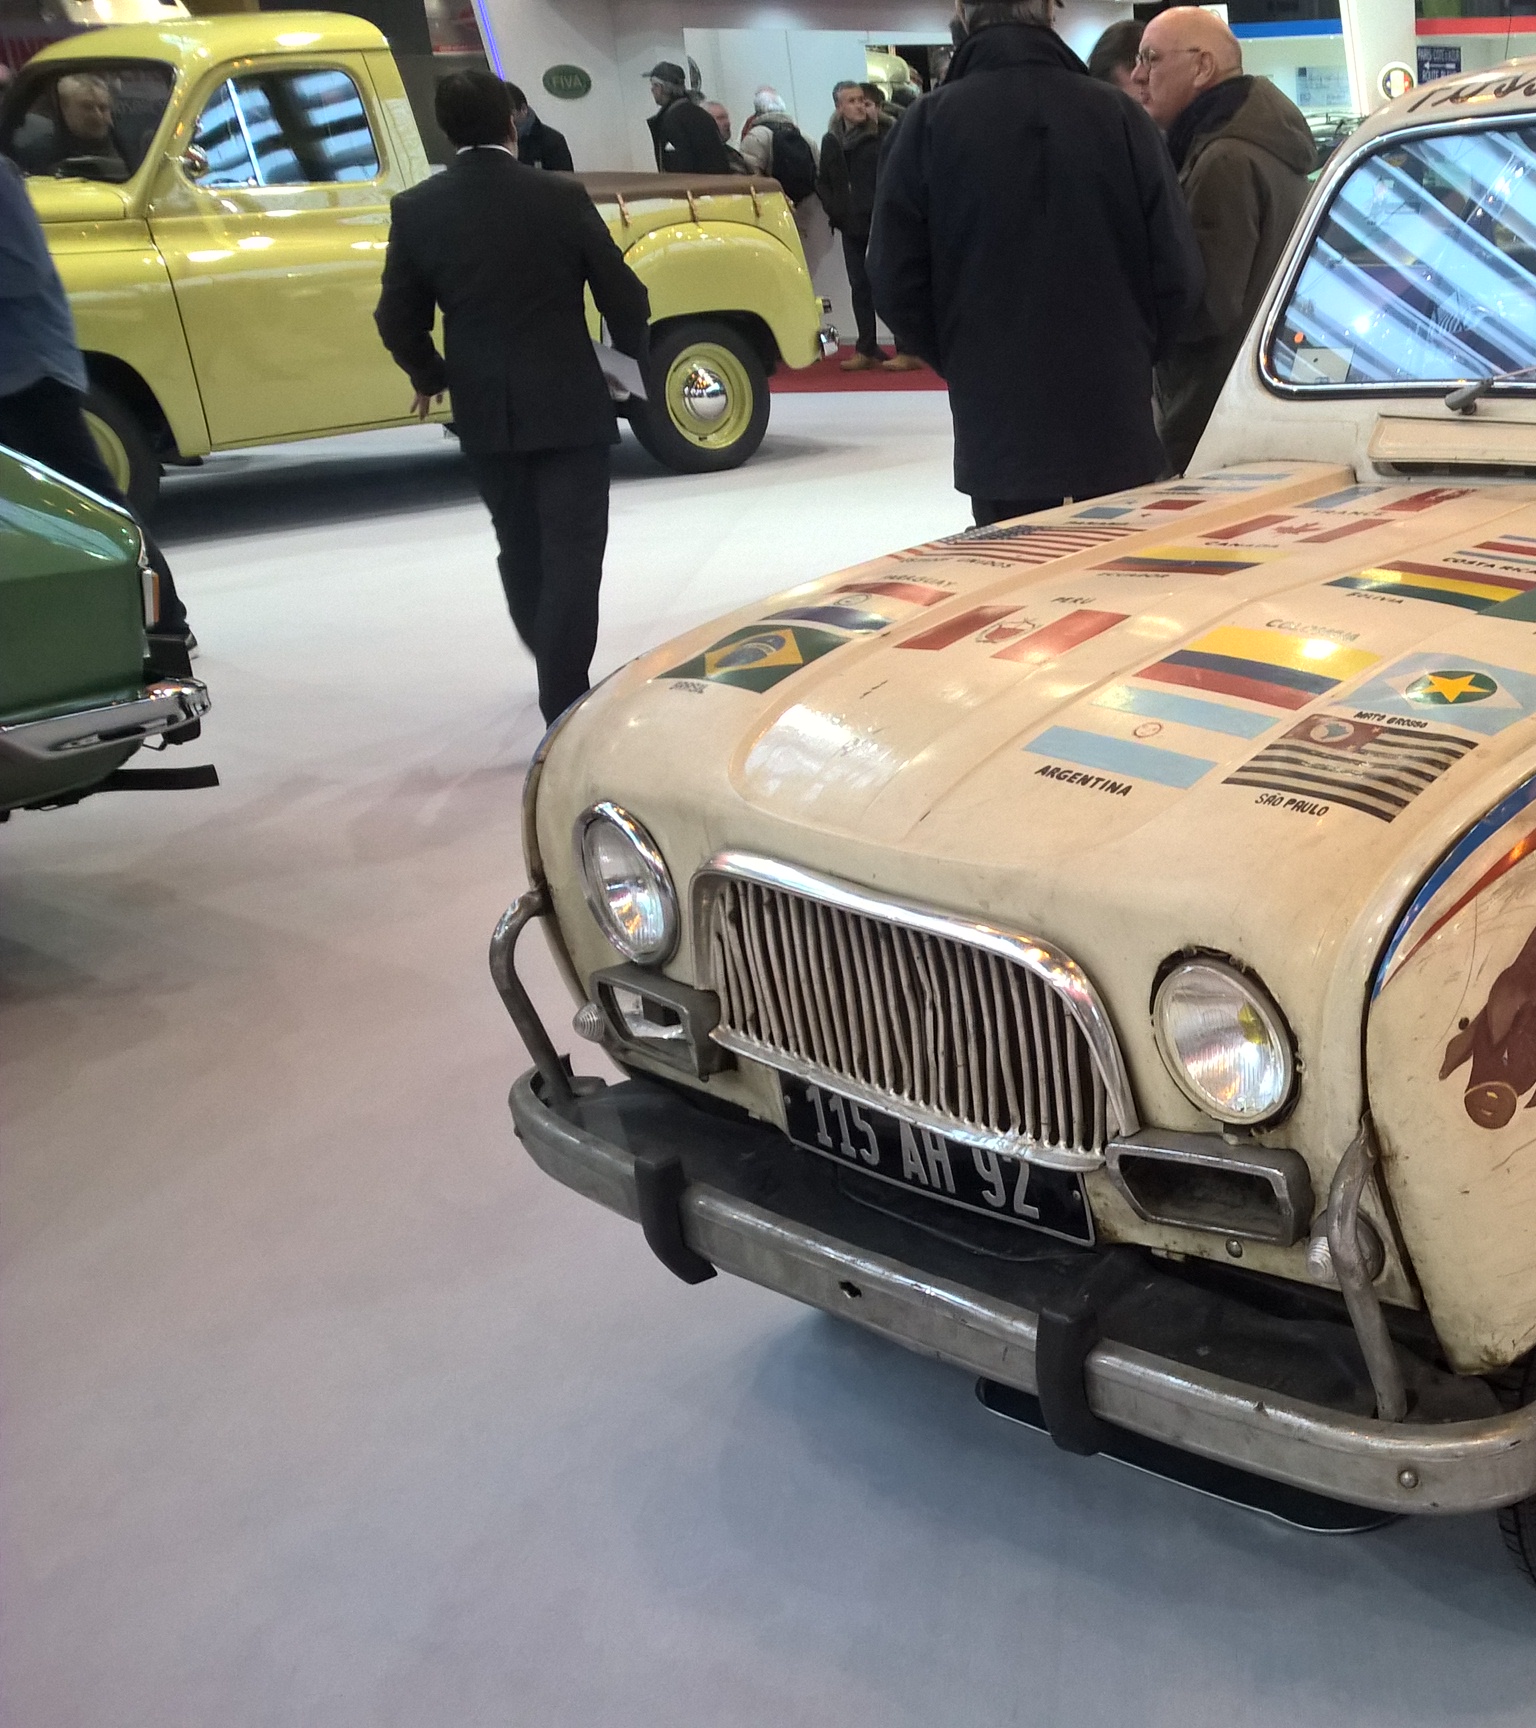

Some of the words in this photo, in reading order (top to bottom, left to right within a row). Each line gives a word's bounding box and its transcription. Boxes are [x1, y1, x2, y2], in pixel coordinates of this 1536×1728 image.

[551, 74, 584, 89] FIVA
[1442, 557, 1496, 568] COSTA
[1050, 596, 1097, 605] PERU
[1353, 711, 1387, 722] MATO
[1386, 717, 1429, 729] GROSSO
[1034, 764, 1133, 797] ARGENTINA
[1283, 798, 1331, 817] PAULO
[806, 1084, 880, 1167] 115
[899, 1120, 955, 1195] AH
[970, 1146, 1040, 1221] 92
